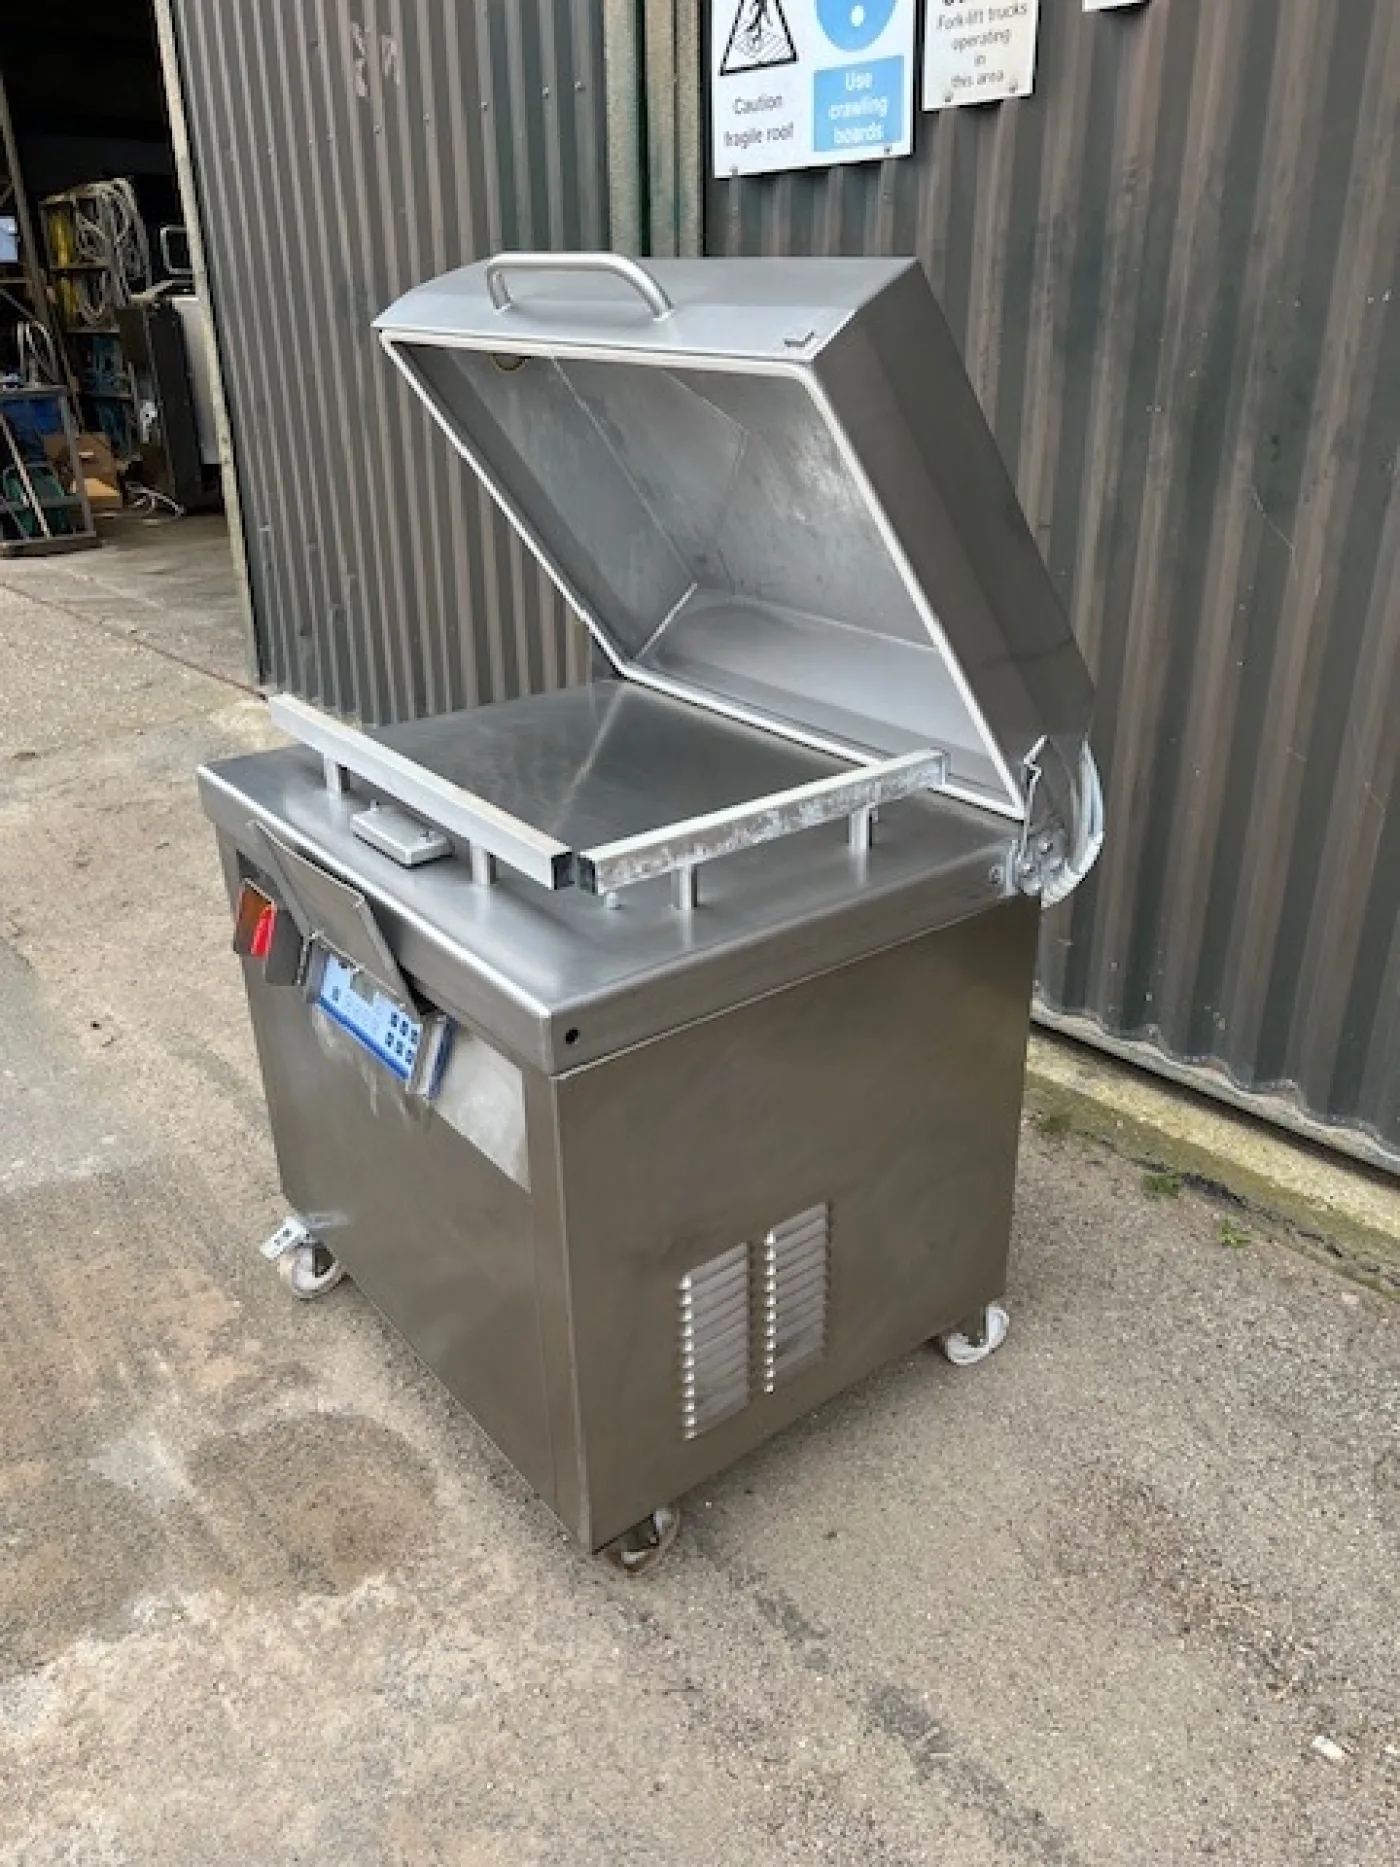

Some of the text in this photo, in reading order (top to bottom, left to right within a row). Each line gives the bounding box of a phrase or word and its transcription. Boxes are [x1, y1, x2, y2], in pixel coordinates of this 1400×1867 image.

[988, 2, 1028, 22] trucks
[951, 29, 1010, 52] operating
[973, 55, 986, 67] in
[844, 71, 872, 91] Use
[952, 71, 1004, 88] this area
[733, 94, 783, 114] Caution
[829, 96, 887, 119] crawling
[724, 122, 794, 149] fragile roof
[834, 123, 882, 143] boards
